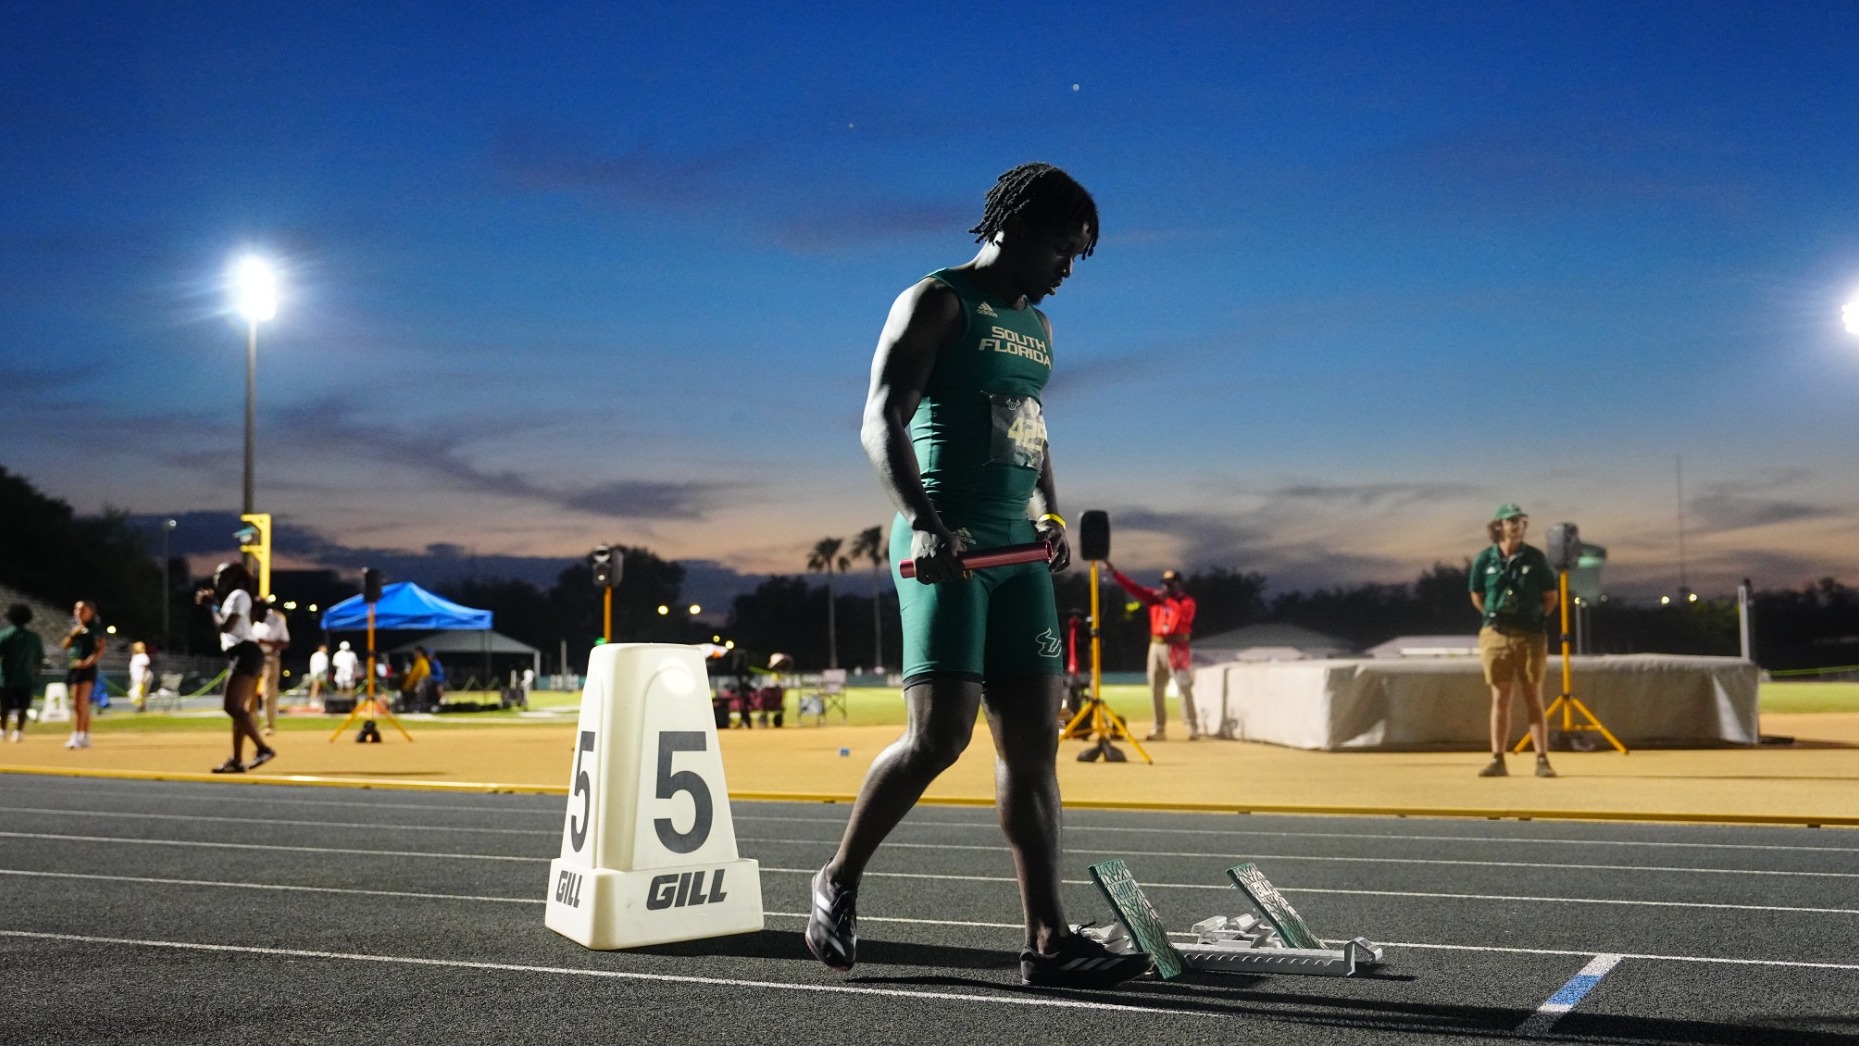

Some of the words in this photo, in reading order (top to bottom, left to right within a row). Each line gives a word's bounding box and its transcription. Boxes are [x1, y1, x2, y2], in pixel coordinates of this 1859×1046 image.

[978, 338, 1052, 369] FLORIDA
[991, 325, 1046, 353] SOUTH
[570, 730, 596, 853] 5
[653, 730, 714, 854] 5
[555, 869, 584, 909] GILL
[646, 868, 728, 911] GILL
